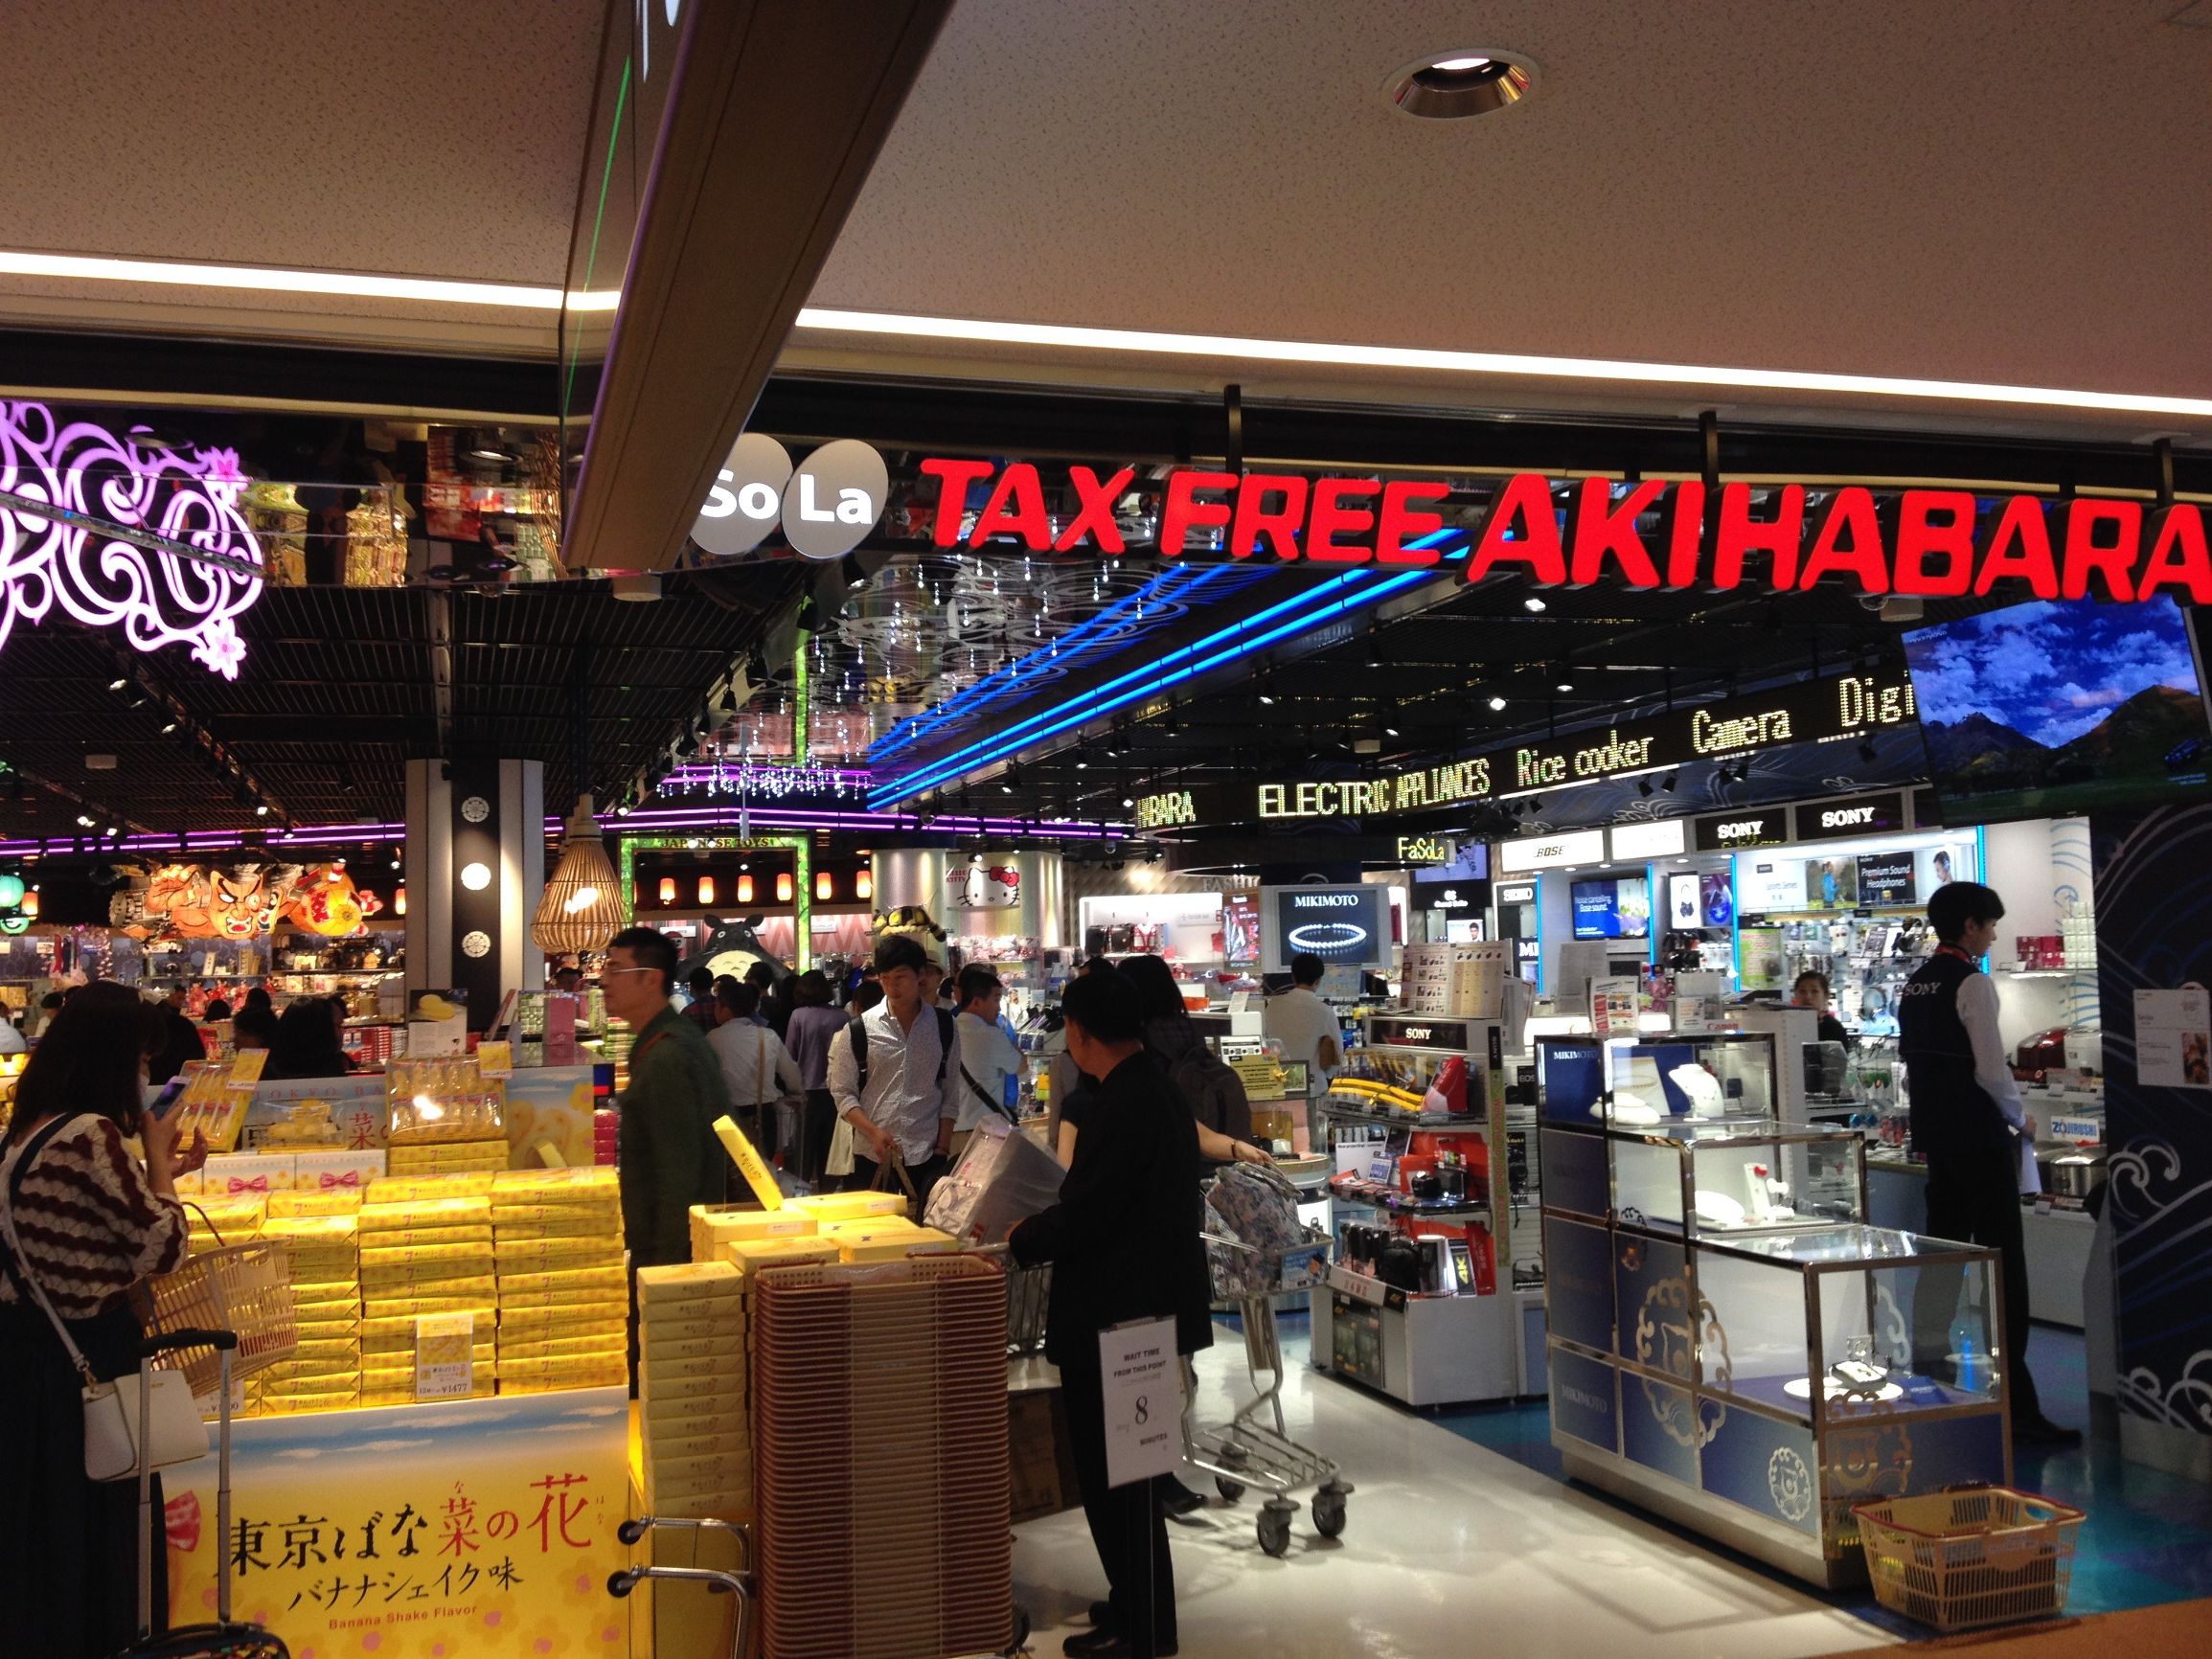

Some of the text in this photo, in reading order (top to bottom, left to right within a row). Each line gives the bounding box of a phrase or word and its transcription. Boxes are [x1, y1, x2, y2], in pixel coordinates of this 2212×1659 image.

[699, 468, 779, 520] So
[799, 473, 874, 525] La
[920, 458, 2212, 605] TAX FREE AKIHABARA
[1259, 779, 1390, 819] ELECTRIC
[1396, 758, 1491, 809] APPLIANCES
[1516, 748, 1566, 787] Rice
[1574, 729, 1654, 777] cooker
[1692, 709, 1792, 755] Camera
[1839, 670, 1915, 727] Digi
[1822, 807, 1876, 829] SONY
[1717, 820, 1765, 839] SONY
[662, 838, 732, 849] JAPNSE
[1398, 837, 1445, 860] FaSoLa
[1536, 845, 1567, 858] BOSE
[1861, 864, 1911, 877] Premium Sound
[1866, 877, 1906, 889] Headphones
[1294, 895, 1359, 907] MIKIMOTO
[1405, 1027, 1432, 1040] SONY
[1707, 1022, 1739, 1031] Canon
[1553, 1050, 1598, 1060] MIKIMOTO
[1124, 1348, 1160, 1361] WAIT TIME
[1113, 1360, 1167, 1378] FROM THIS POINT
[1134, 1396, 1148, 1425] 8
[216, 1472, 592, 1577] 東京ばな菜の花
[287, 1556, 524, 1611] バナナシェイク味
[329, 1604, 479, 1630] Banana Shake Flavor
